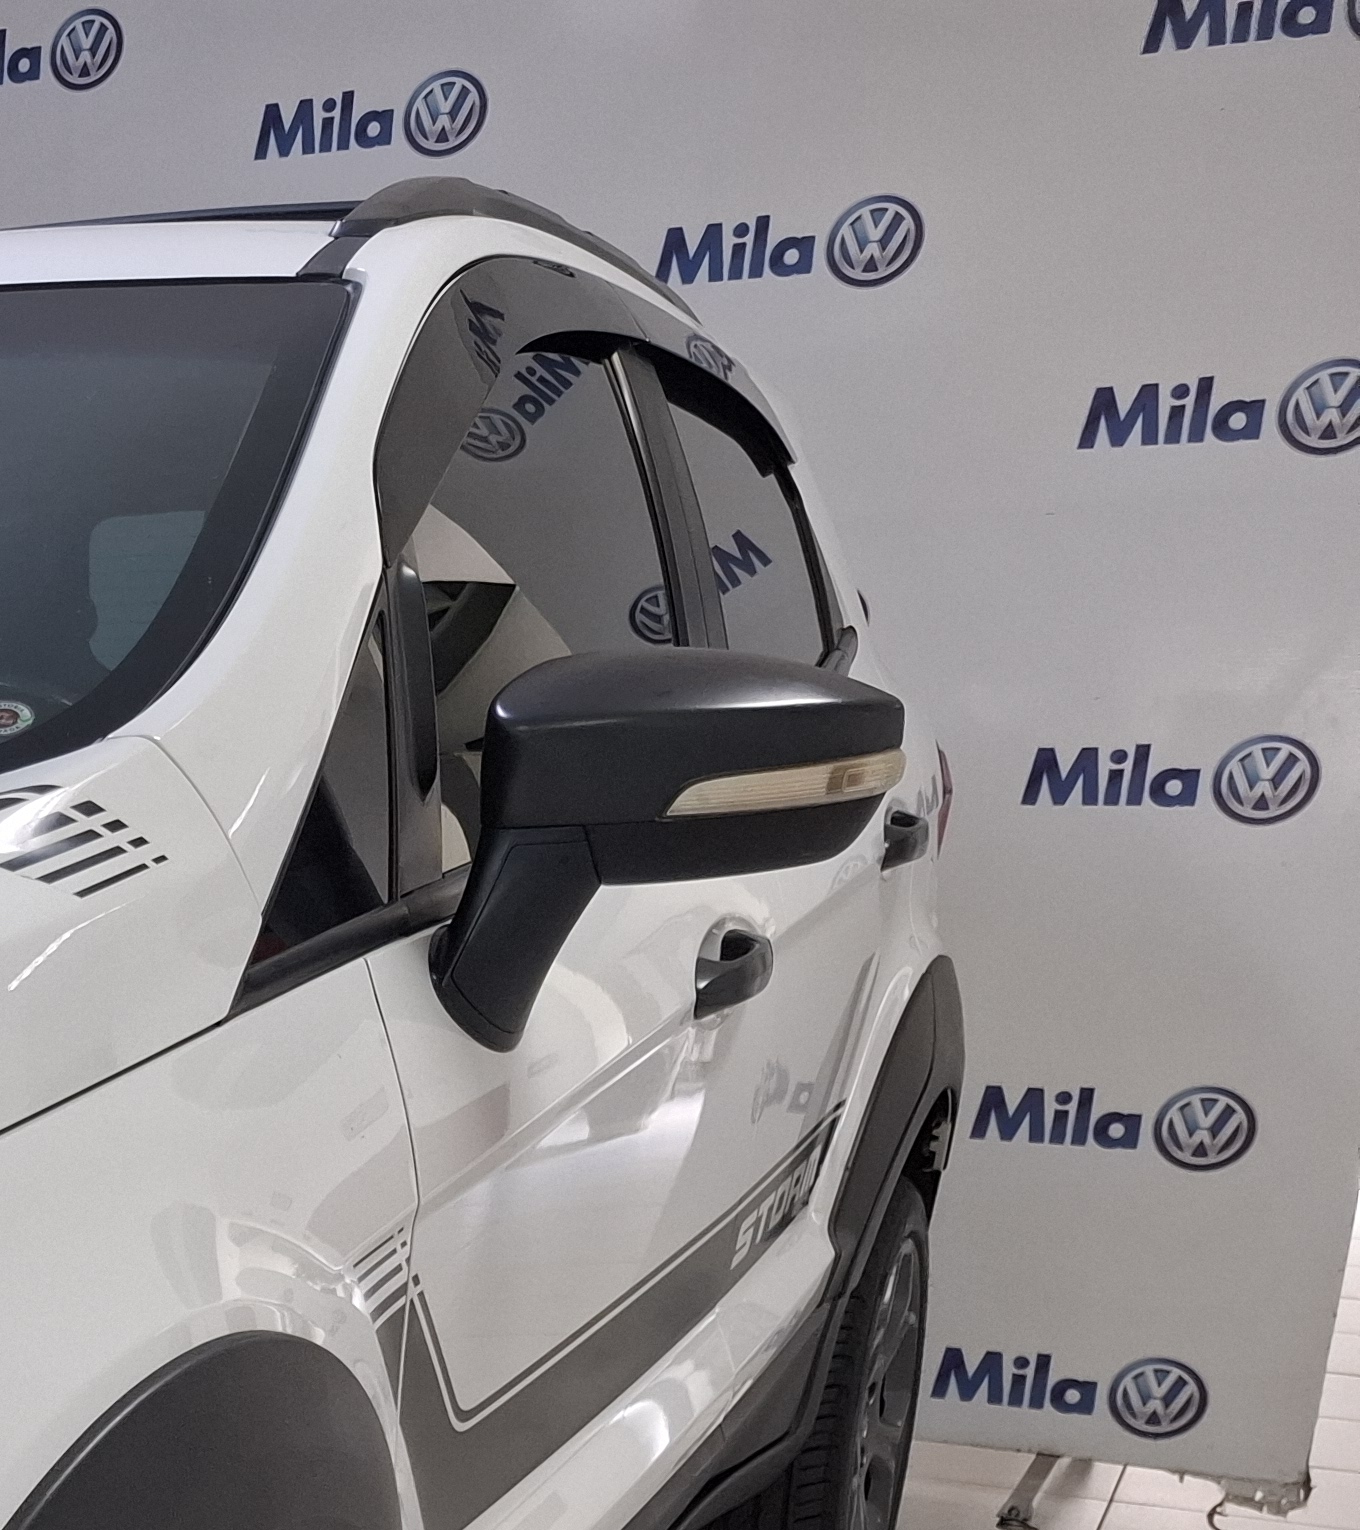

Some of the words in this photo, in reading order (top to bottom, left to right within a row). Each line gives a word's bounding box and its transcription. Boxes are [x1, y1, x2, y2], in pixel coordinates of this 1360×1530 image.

[1142, 0, 1334, 54] Mila
[254, 90, 394, 160] Mila
[655, 215, 815, 284] Mila
[1077, 376, 1266, 449] Mila
[1021, 744, 1200, 807] Mila
[970, 1086, 1142, 1149] Mila
[730, 1144, 821, 1270] STORM
[931, 1347, 1097, 1415] Mila
